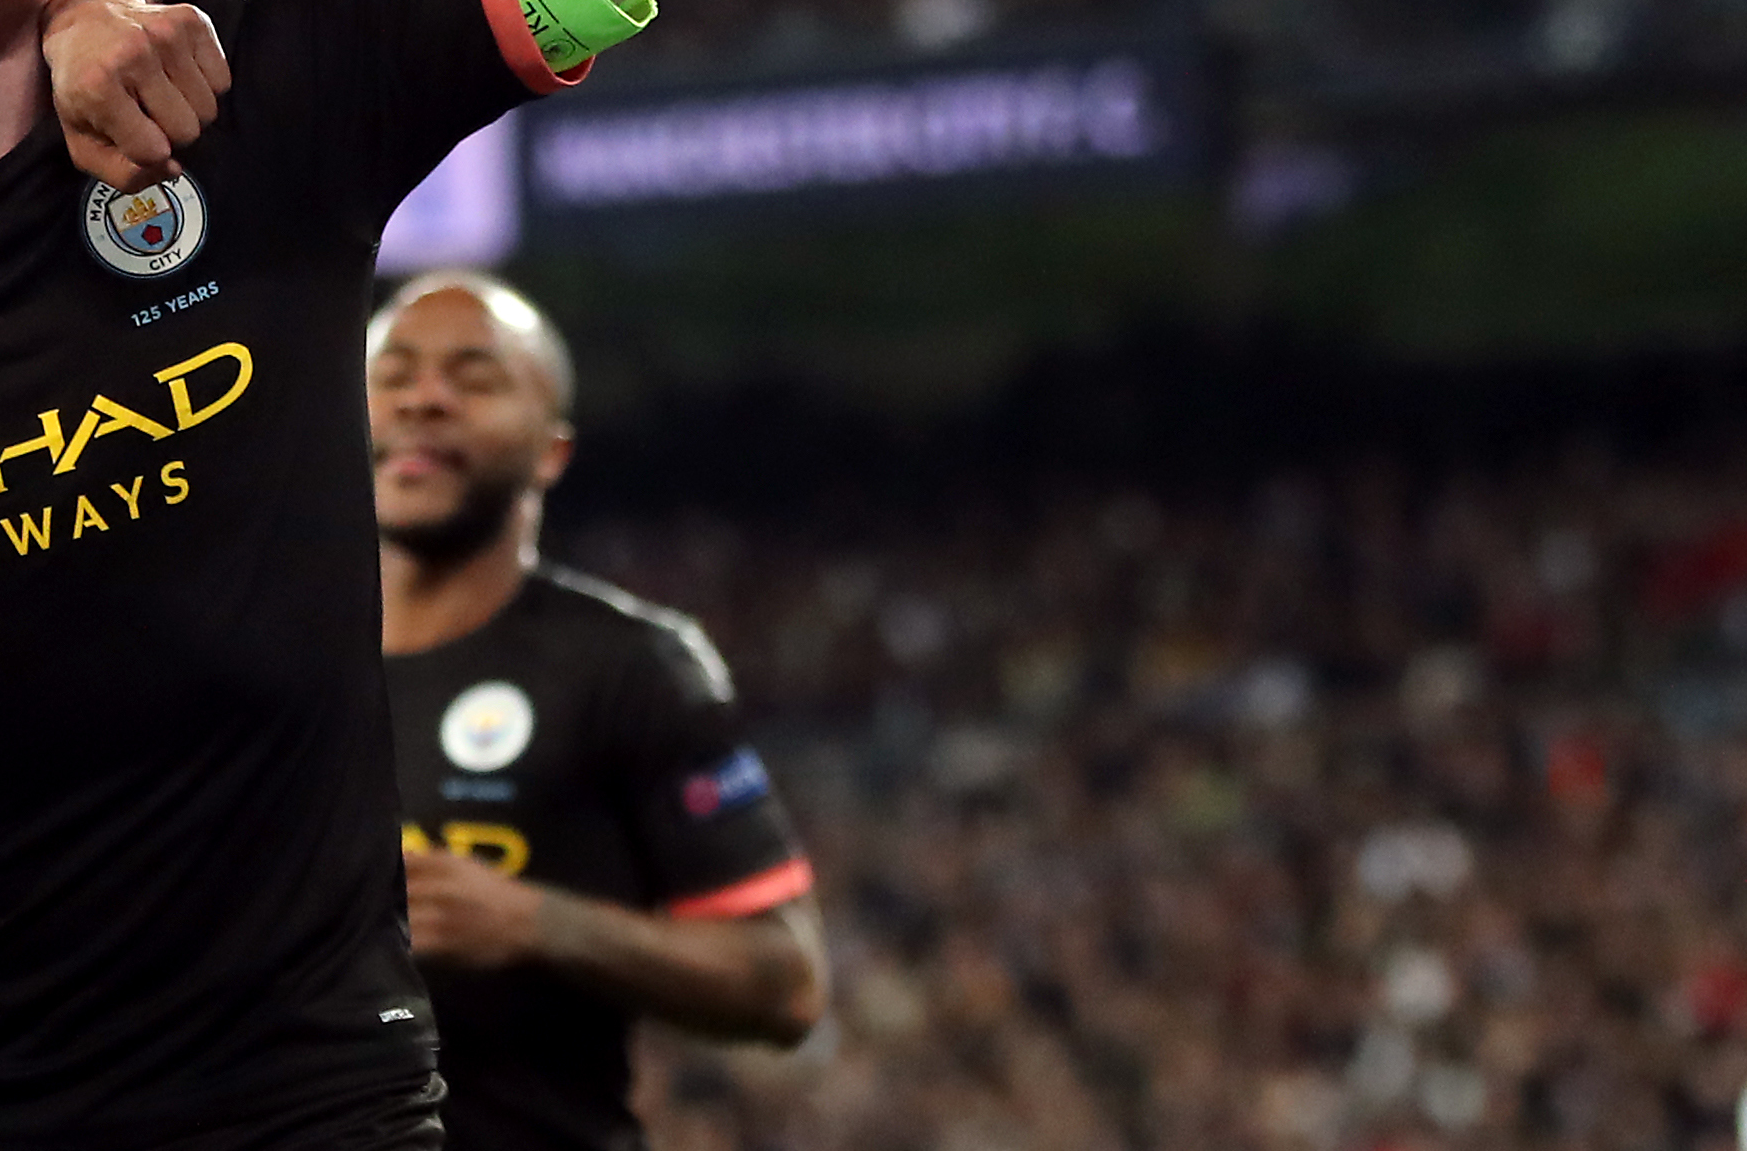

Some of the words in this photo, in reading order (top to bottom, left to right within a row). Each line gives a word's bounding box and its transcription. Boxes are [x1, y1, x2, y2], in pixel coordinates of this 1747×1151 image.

[149, 248, 182, 271] CITY
[131, 306, 162, 327] 125
[165, 280, 220, 313] YEARS
